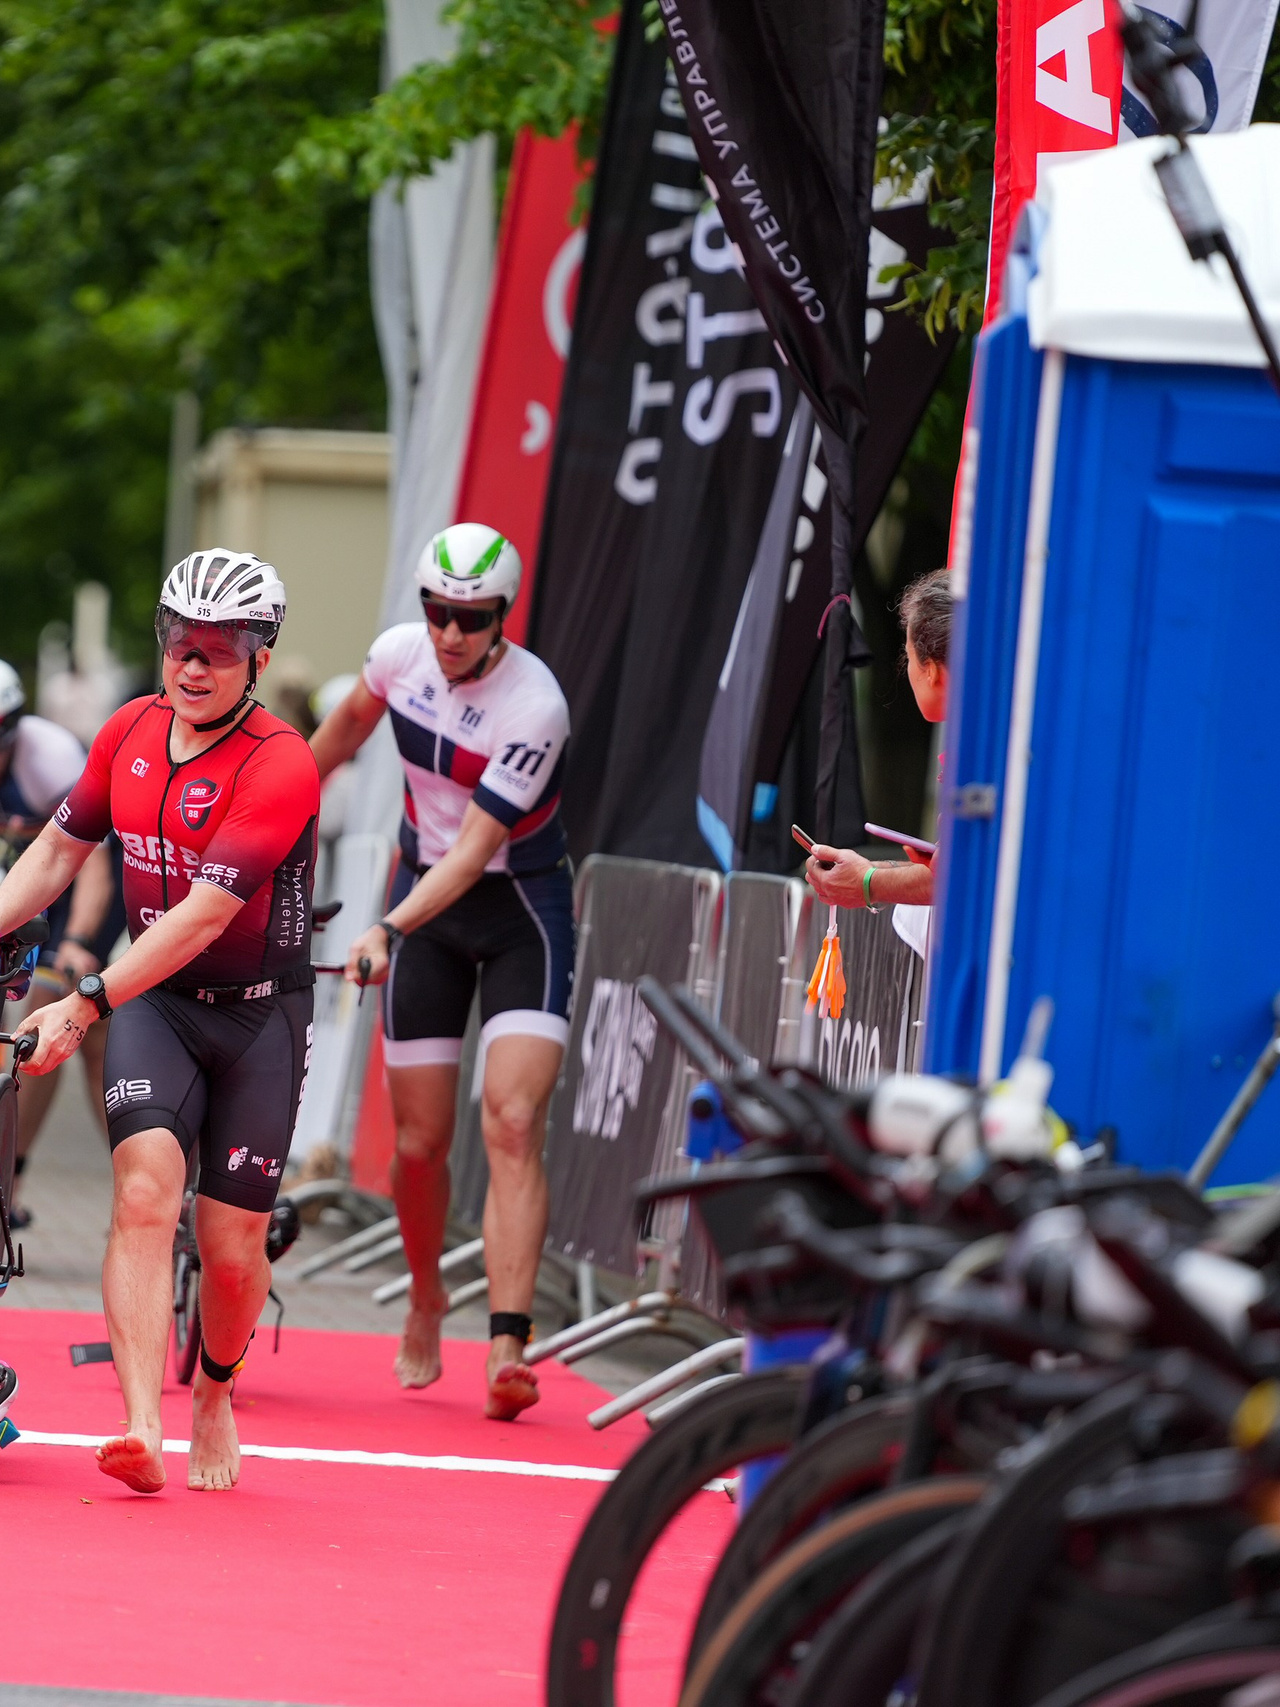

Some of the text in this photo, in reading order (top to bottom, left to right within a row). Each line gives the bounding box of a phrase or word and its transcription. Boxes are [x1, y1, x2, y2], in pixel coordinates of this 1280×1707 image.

[730, 163, 826, 325] СИСТЕМА
[196, 606, 212, 618] 515
[500, 739, 552, 776] Tri
[189, 787, 208, 797] SBR
[187, 809, 200, 819] 88
[123, 851, 179, 877] RONMAN
[200, 862, 240, 879] GES
[292, 859, 307, 946] ТРИАТЛОН
[64, 1019, 85, 1041] 515
